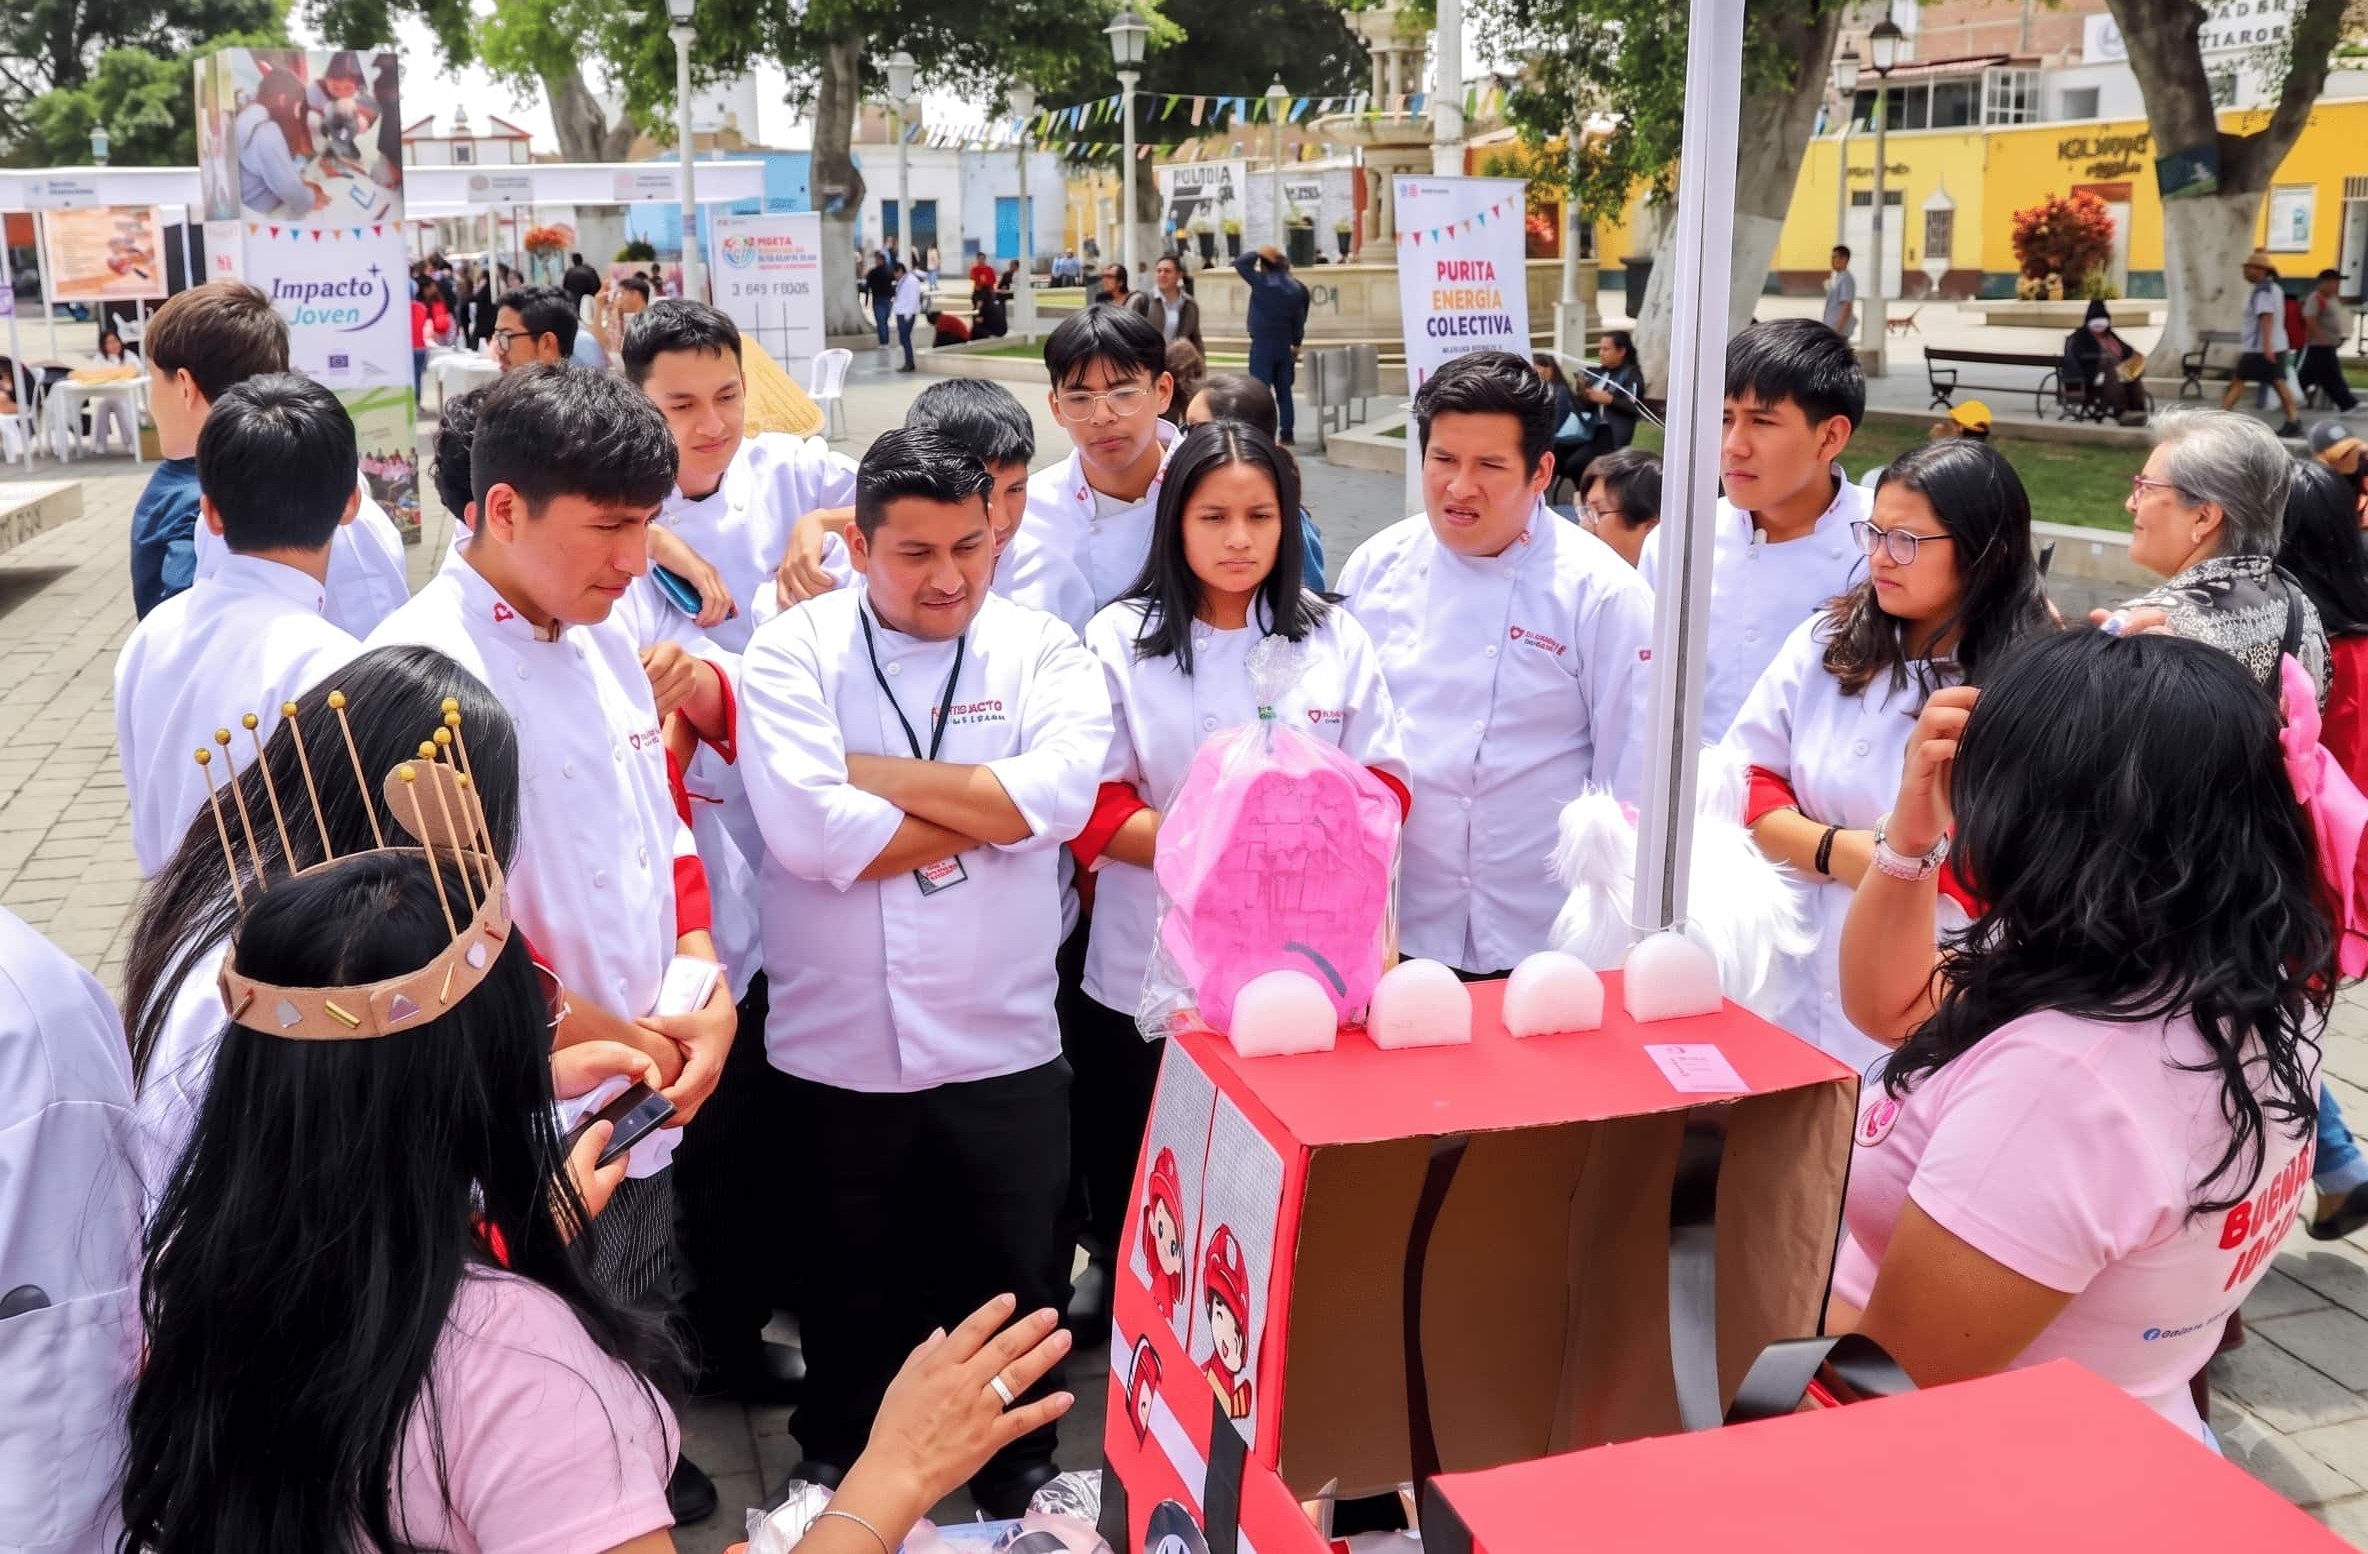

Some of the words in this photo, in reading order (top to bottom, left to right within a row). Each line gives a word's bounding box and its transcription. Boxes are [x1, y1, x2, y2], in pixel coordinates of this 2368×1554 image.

[1436, 260, 1496, 281] PURITA
[271, 277, 373, 304] Impacto
[1432, 286, 1503, 311] ENERGÍA
[287, 305, 361, 326] Joven
[1426, 315, 1514, 337] COLECTIVA
